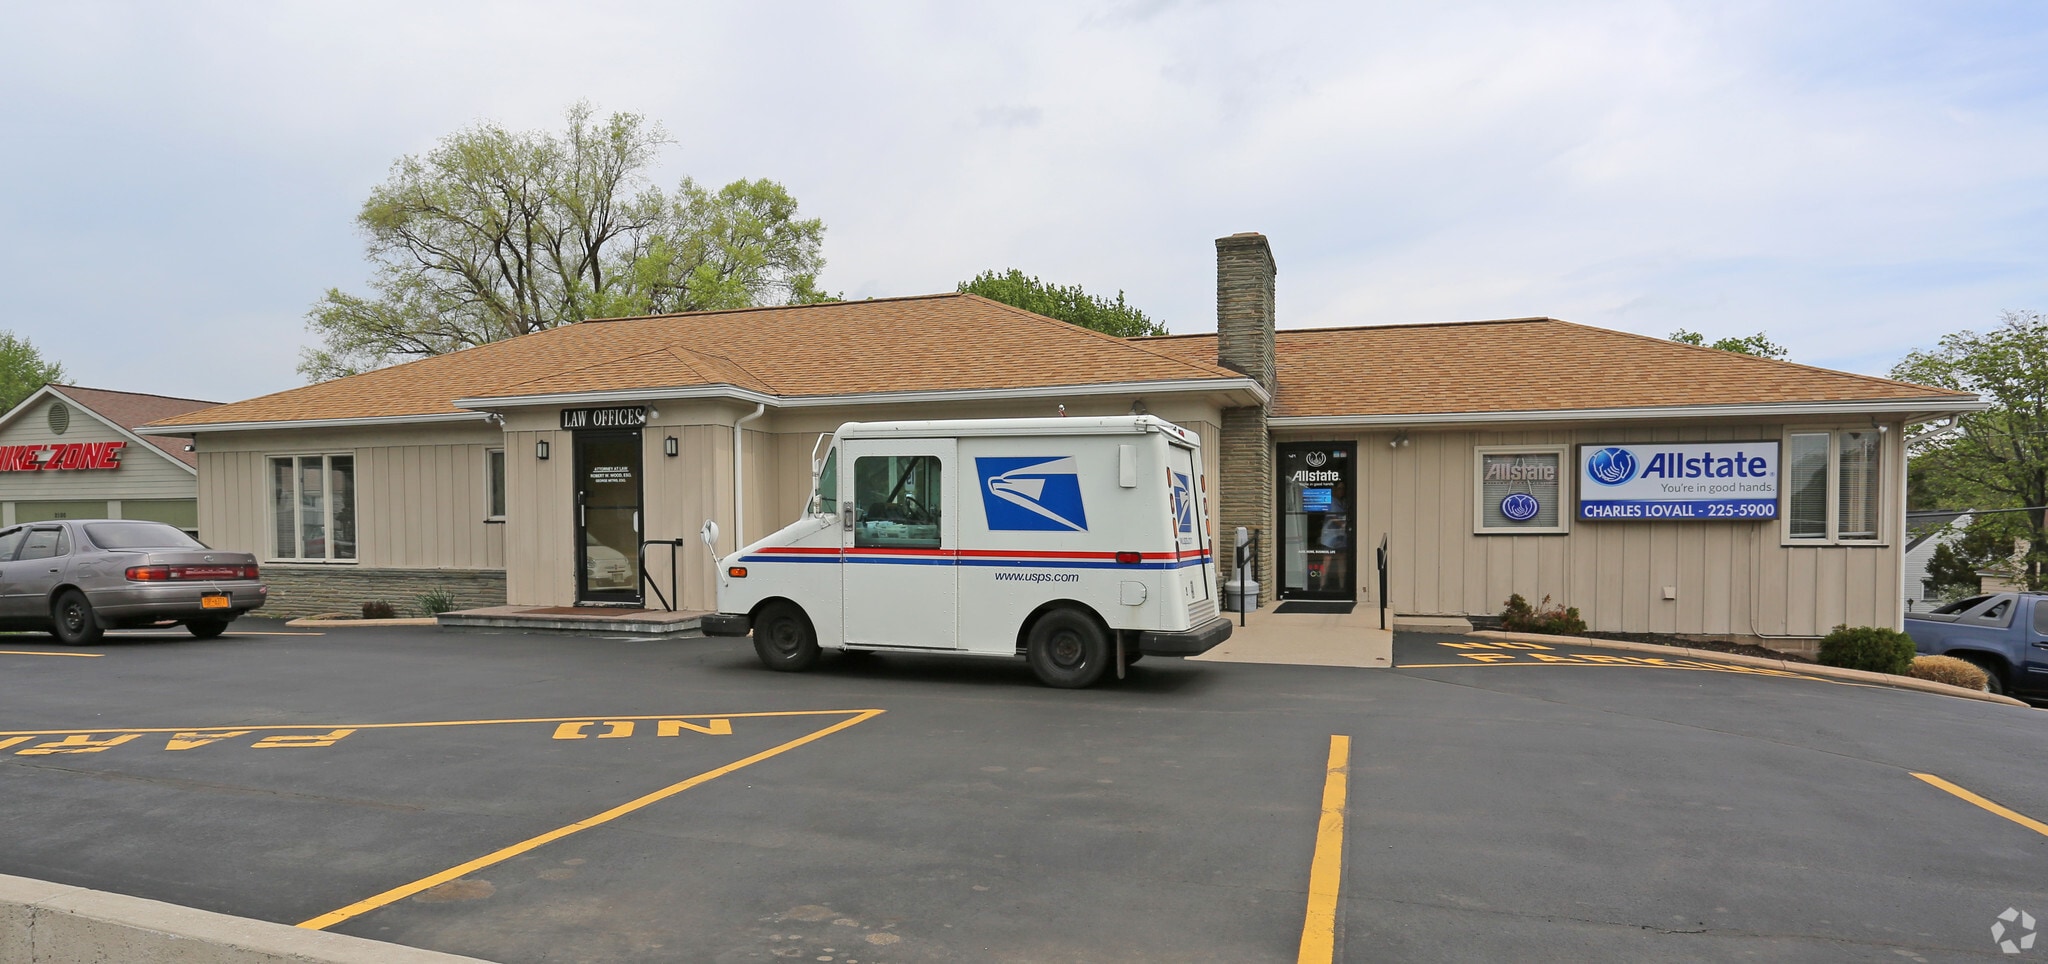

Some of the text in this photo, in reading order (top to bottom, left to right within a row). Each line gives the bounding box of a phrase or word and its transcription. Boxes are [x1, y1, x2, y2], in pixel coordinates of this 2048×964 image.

[564, 408, 644, 427] LAW OFFICES
[43, 441, 127, 470] ZONE
[1484, 462, 1555, 480] Allstate
[1641, 452, 1767, 479] Allstate
[1292, 470, 1339, 482] Allstate
[1661, 482, 1775, 495] You're in good hands.
[1584, 504, 1642, 517] CHARLES
[1645, 504, 1695, 517] LOVALL
[1707, 503, 1775, 517] 225-5900
[995, 572, 1079, 584] www.usps.com
[552, 718, 733, 740] NO
